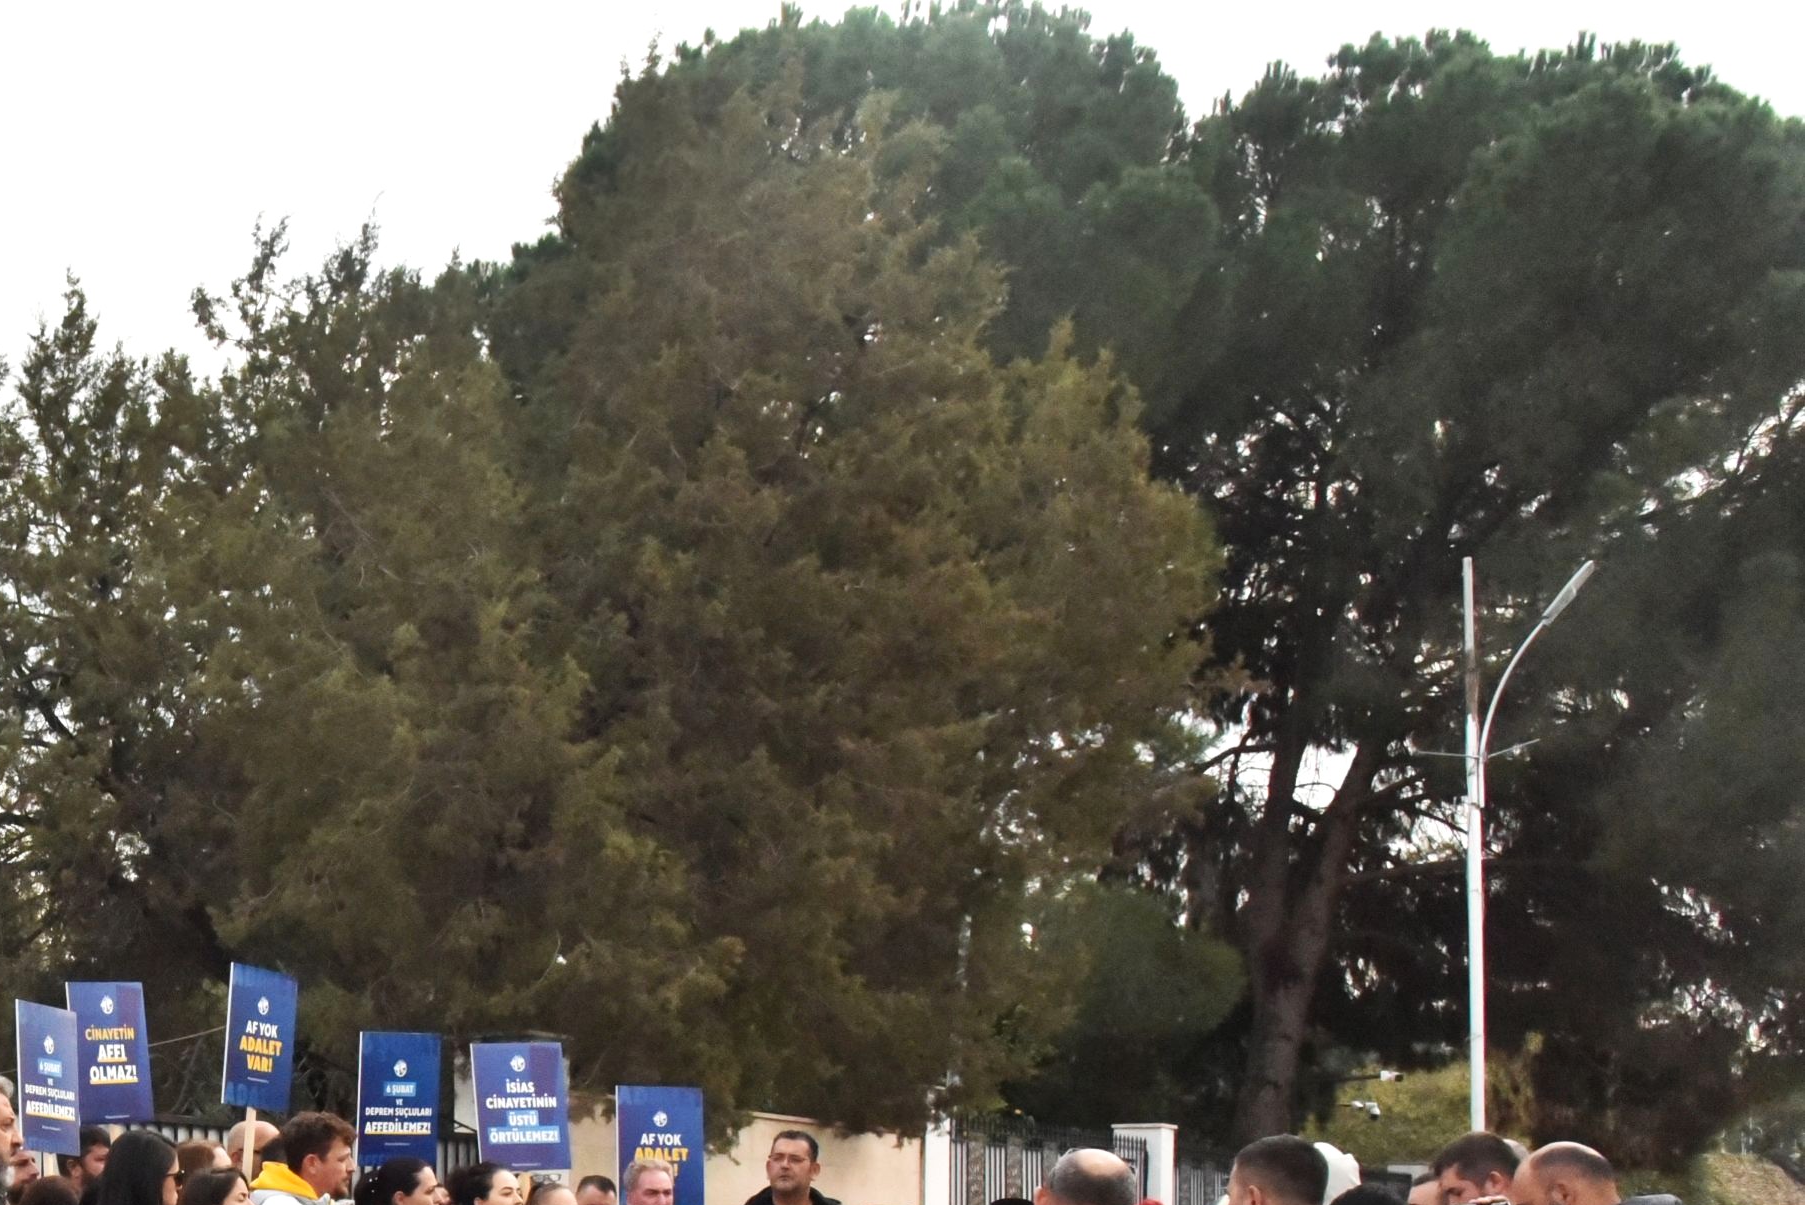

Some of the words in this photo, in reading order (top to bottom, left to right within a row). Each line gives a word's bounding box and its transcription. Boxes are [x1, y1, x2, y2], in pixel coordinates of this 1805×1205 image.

[84, 1024, 135, 1041] CİNAYETİN
[245, 1020, 258, 1035] AF
[259, 1022, 278, 1039] YOK
[239, 1035, 283, 1056] ADALET
[247, 1053, 273, 1073] VAR!
[89, 1065, 138, 1081] OLMAZ!
[25, 1083, 47, 1096] DEPREM
[386, 1084, 391, 1094] 6
[392, 1085, 414, 1096] ŞUBAT
[506, 1078, 535, 1093] İSİAS
[25, 1099, 76, 1117] AFFEDİLEMEZ!
[396, 1098, 403, 1106] VE
[486, 1093, 557, 1109] CİNAYETİNİN
[365, 1107, 394, 1116] DEPREM
[395, 1107, 432, 1118] SUÇLULARI
[508, 1111, 537, 1126] ÜSTÜ
[364, 1118, 431, 1133] AFFEDİLEMEZ!
[490, 1127, 559, 1143] ÖRTÜLEMEZ!
[640, 1133, 655, 1146] AF
[657, 1133, 682, 1146] YOK
